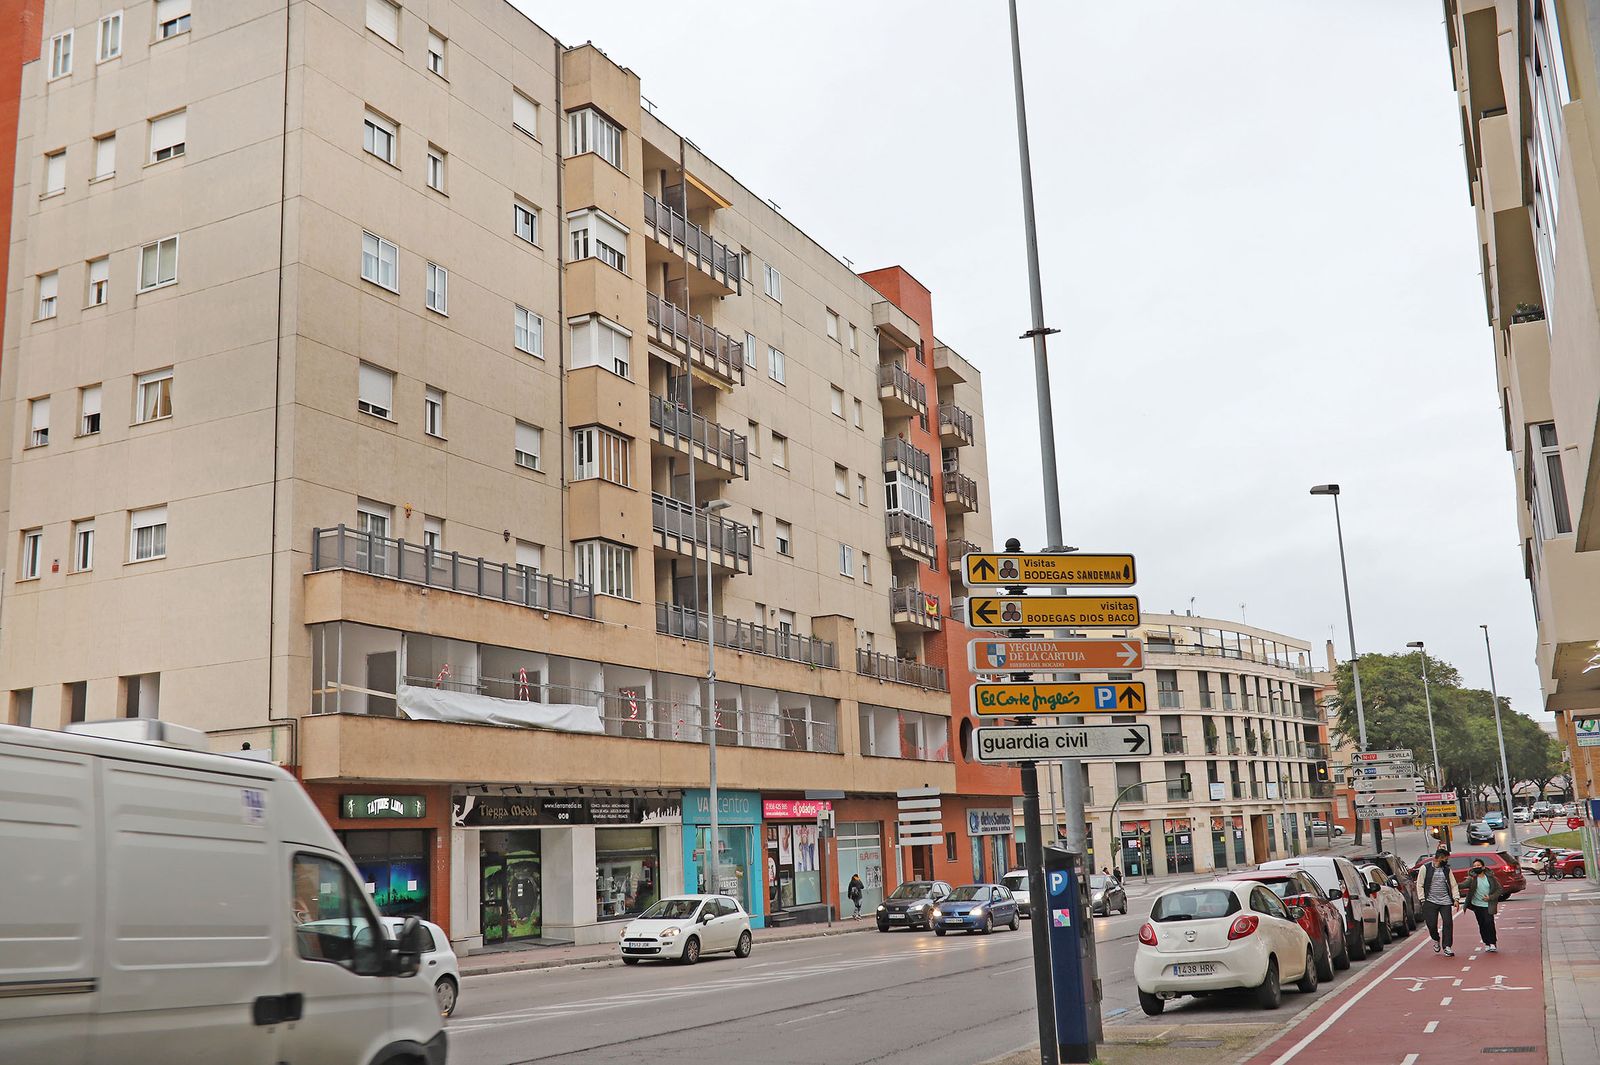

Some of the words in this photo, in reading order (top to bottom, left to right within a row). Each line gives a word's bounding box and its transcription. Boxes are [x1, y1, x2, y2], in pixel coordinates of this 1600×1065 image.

[1024, 558, 1056, 568] Visitas
[1024, 570, 1075, 580] BODEGAS
[1076, 570, 1121, 580] SANDEMAN
[1100, 602, 1134, 611] visitas
[1027, 614, 1076, 623] BODEGAS
[1079, 613, 1104, 622] DIOS
[1108, 613, 1135, 622] BACO
[1009, 642, 1058, 652] YEGUADA
[1009, 652, 1025, 661] DE
[1026, 652, 1040, 661] LA
[1040, 652, 1086, 662] CARTUJA
[981, 690, 996, 706] El
[996, 690, 1030, 706] Corte
[1032, 686, 1080, 710] Inglés
[1097, 687, 1113, 707] P
[983, 732, 1049, 753] guardia
[1055, 732, 1088, 748] civil
[1051, 873, 1063, 891] P
[1177, 965, 1198, 974] 1438
[1199, 964, 1216, 973] HRK
